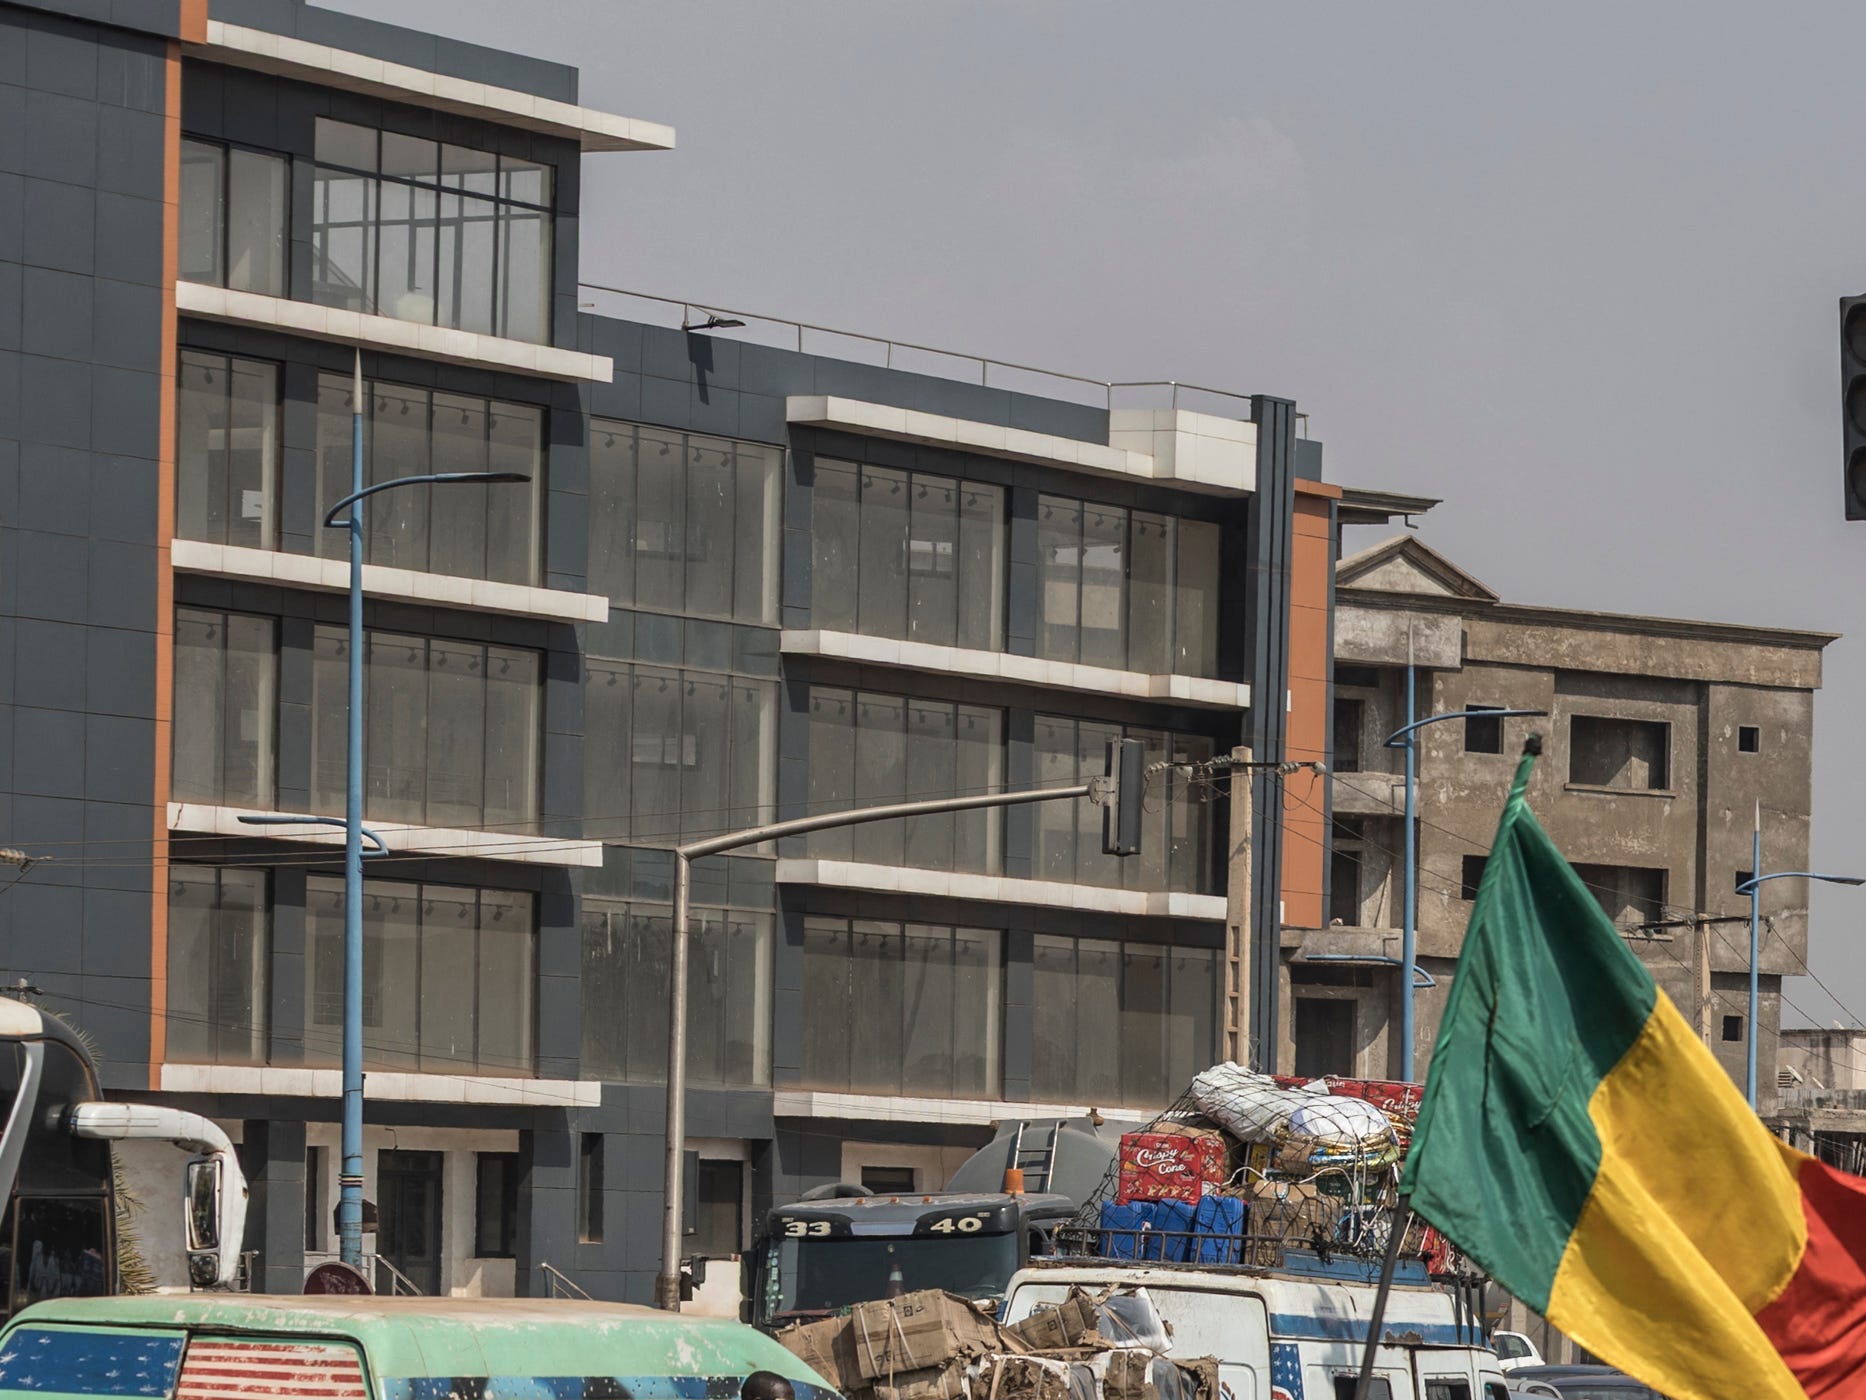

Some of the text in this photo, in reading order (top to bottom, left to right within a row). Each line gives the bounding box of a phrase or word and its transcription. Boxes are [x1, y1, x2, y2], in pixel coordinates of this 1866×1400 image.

[1159, 1163, 1186, 1174] Cone
[785, 1217, 982, 1237] 33 40
